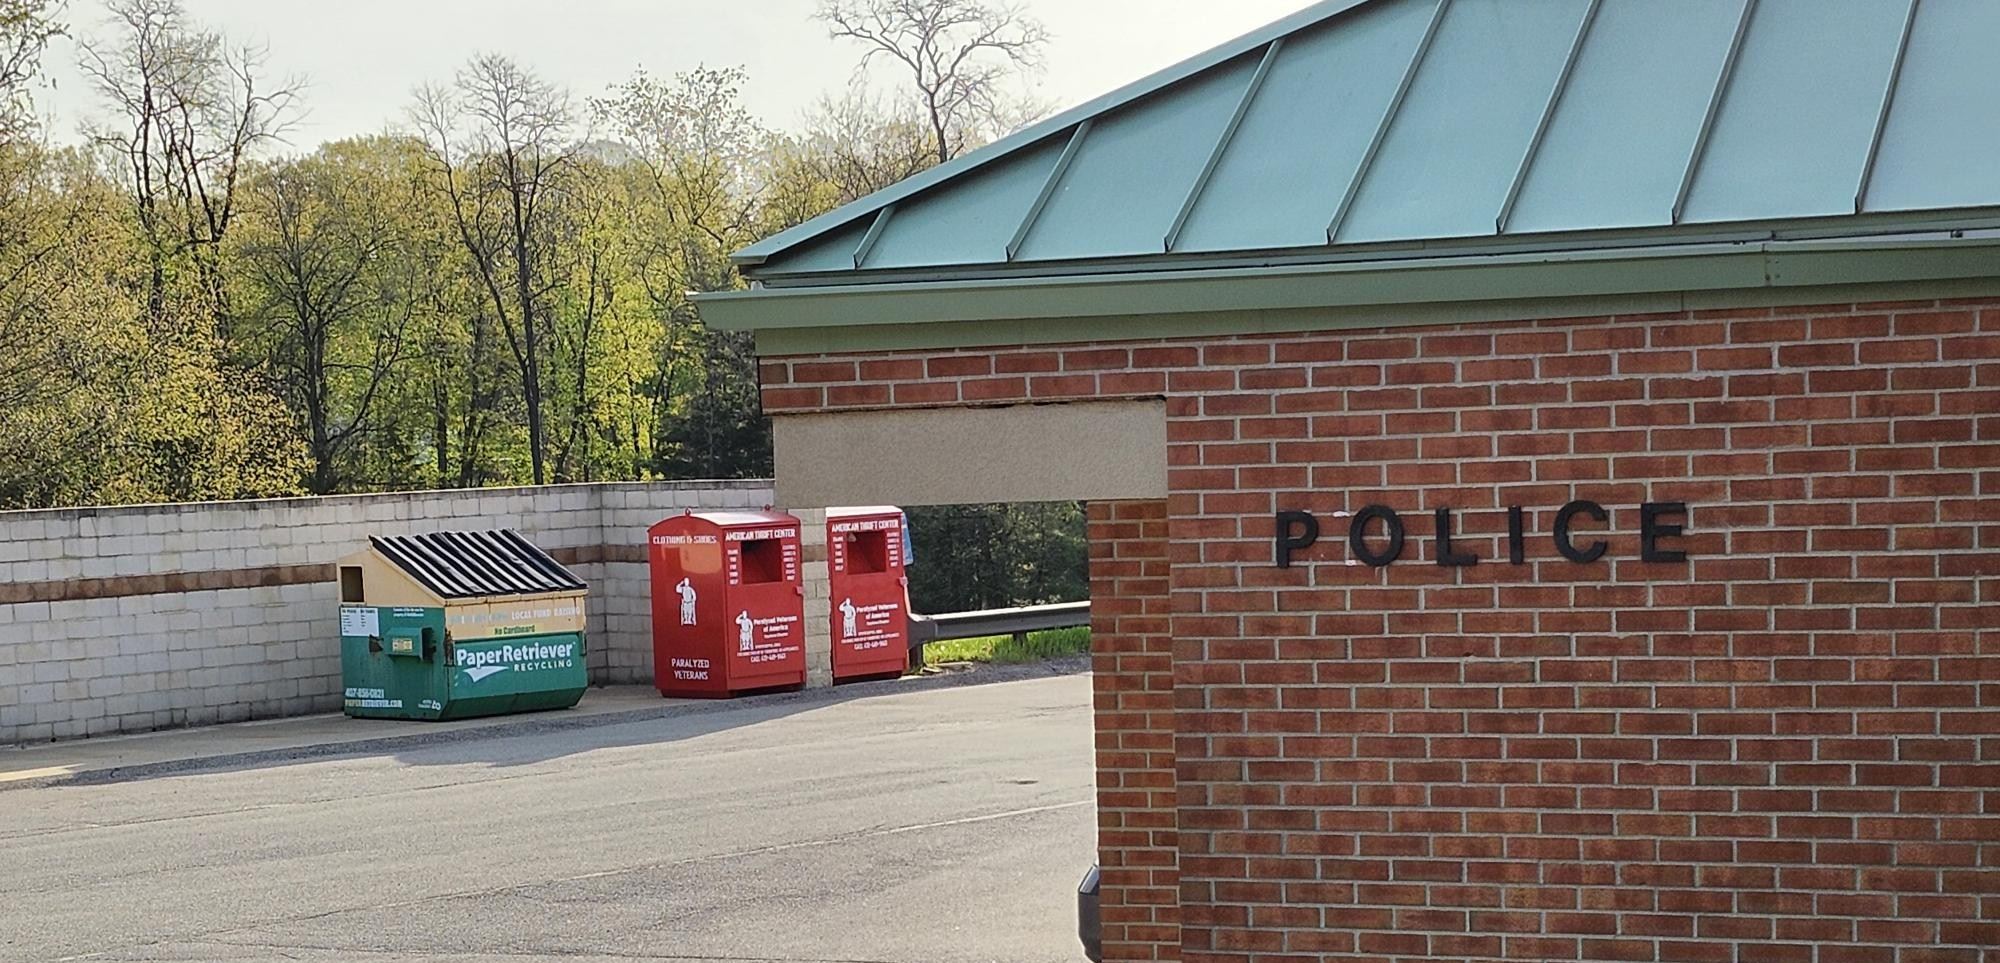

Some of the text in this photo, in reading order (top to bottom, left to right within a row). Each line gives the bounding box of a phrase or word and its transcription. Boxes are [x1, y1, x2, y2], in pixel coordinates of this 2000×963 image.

[653, 535, 685, 545] CLOTHING
[693, 535, 717, 544] SHOES
[725, 529, 796, 541] AMERICAN THRIFT CENTER
[1276, 500, 1687, 569] POLICE
[511, 609, 532, 620] LOCAL
[533, 608, 552, 618] FUND
[494, 625, 535, 635] No Cardboard
[456, 642, 573, 669] PaperRetriever
[514, 659, 572, 672] RECYCLING
[671, 657, 710, 668] PARALYZED
[674, 670, 709, 681] VETERANS
